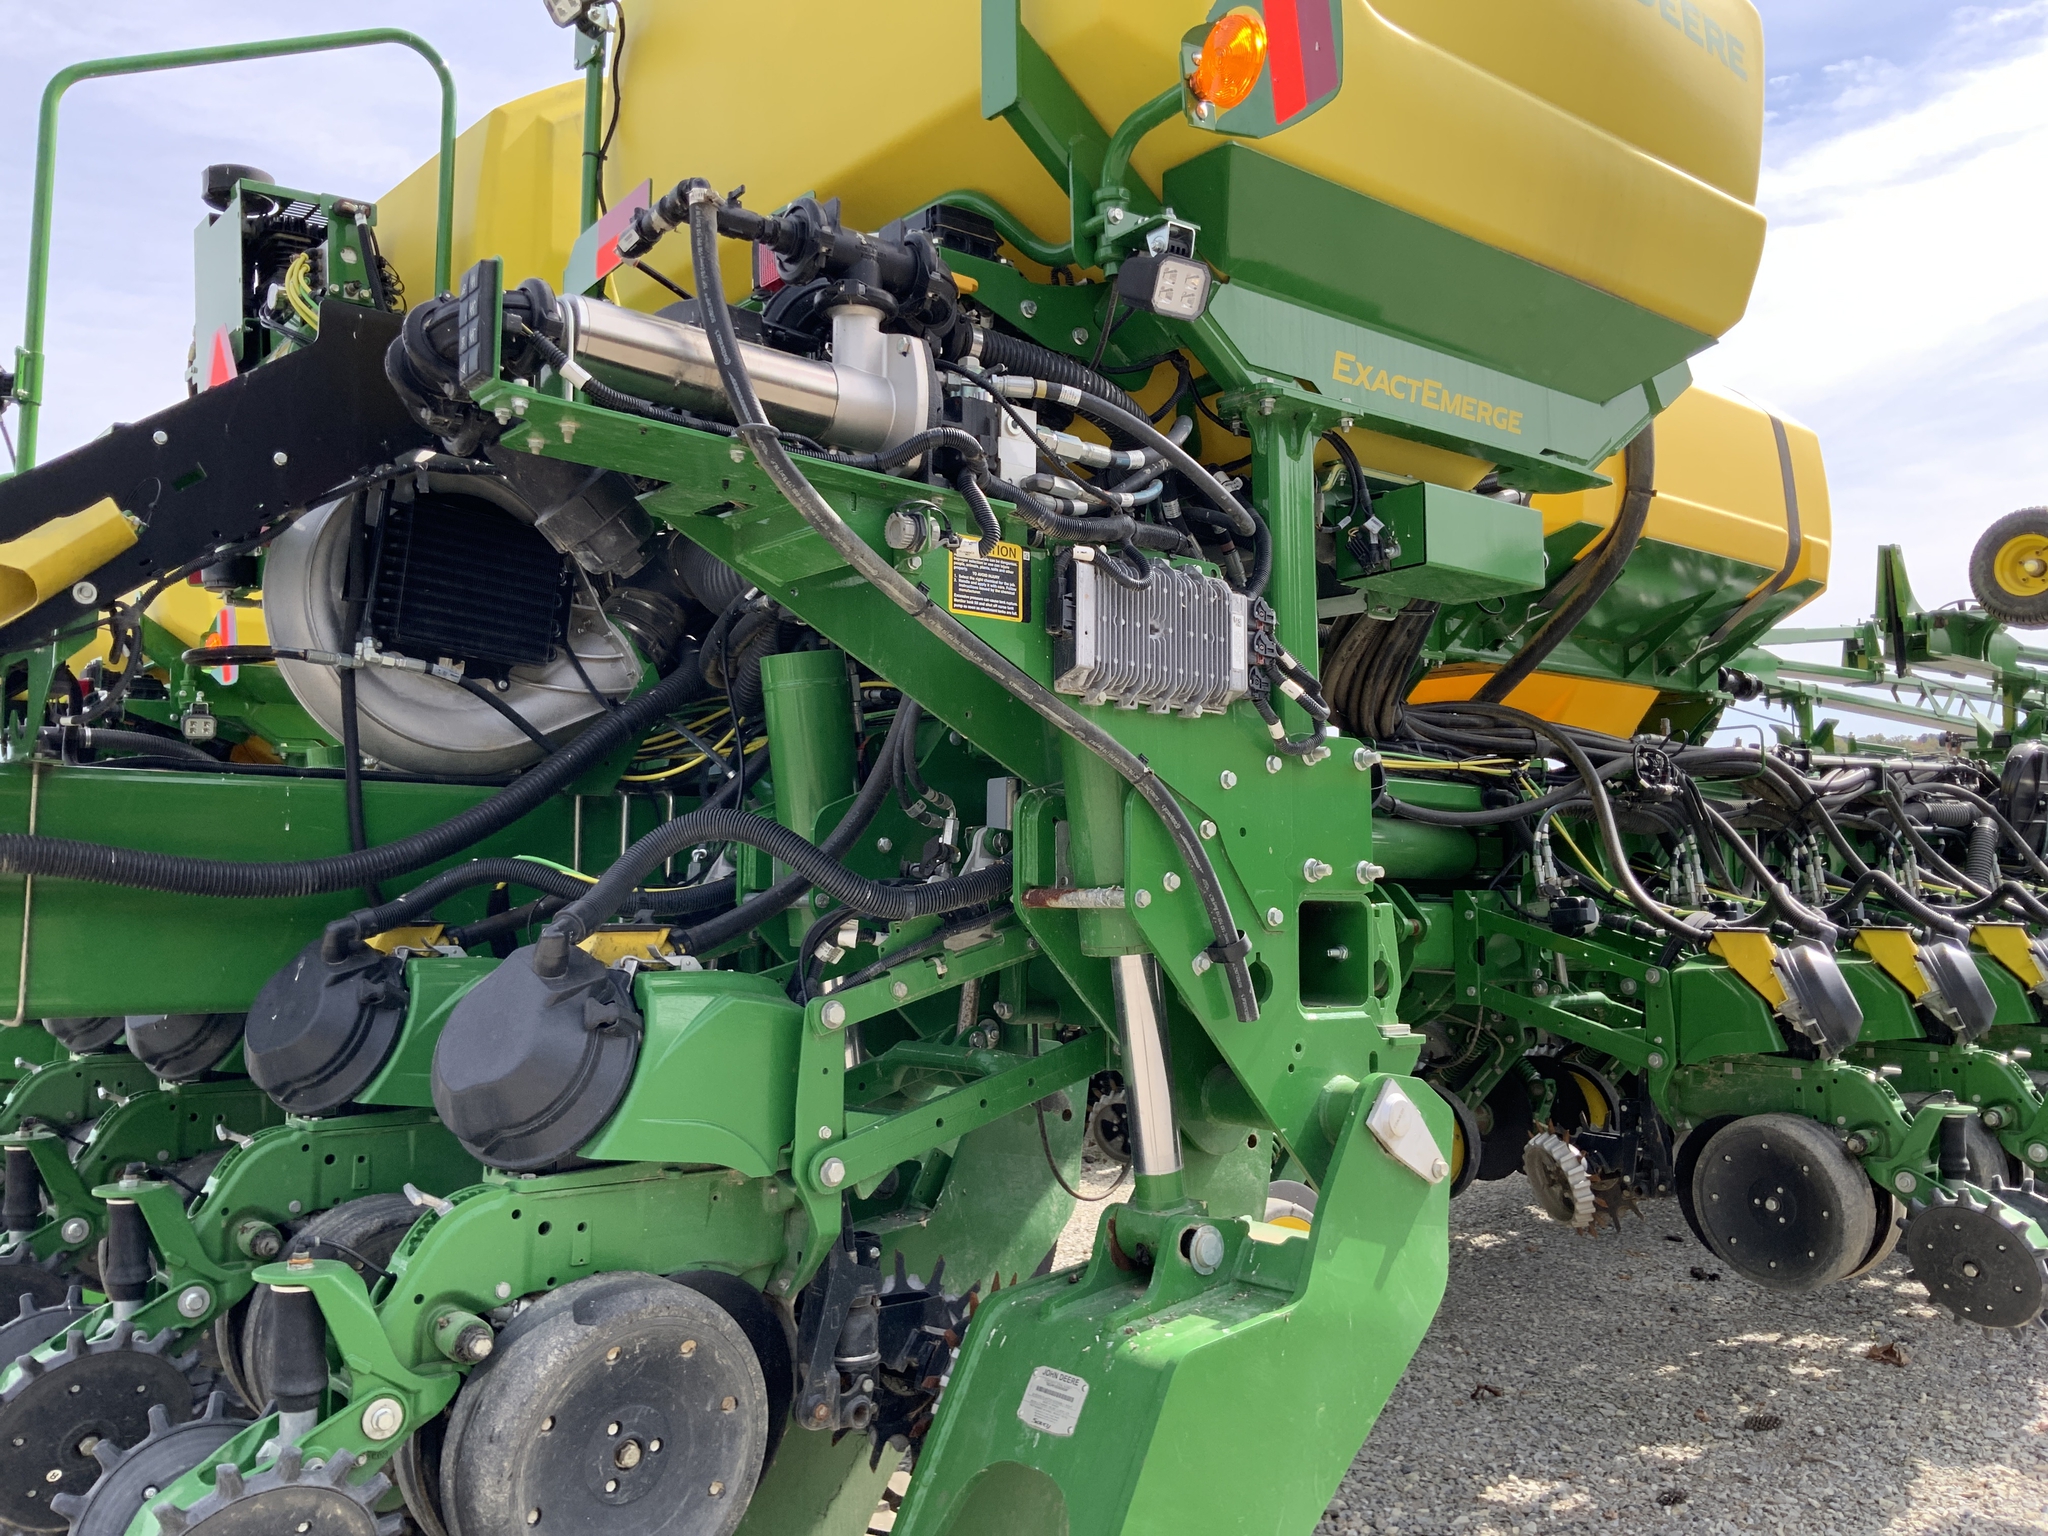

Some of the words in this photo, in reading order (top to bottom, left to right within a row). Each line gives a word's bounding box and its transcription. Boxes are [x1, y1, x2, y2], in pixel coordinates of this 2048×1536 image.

[1637, 0, 1748, 82] EERE
[1042, 1370, 1059, 1379] JOHN
[1059, 1374, 1080, 1386] DEERE
